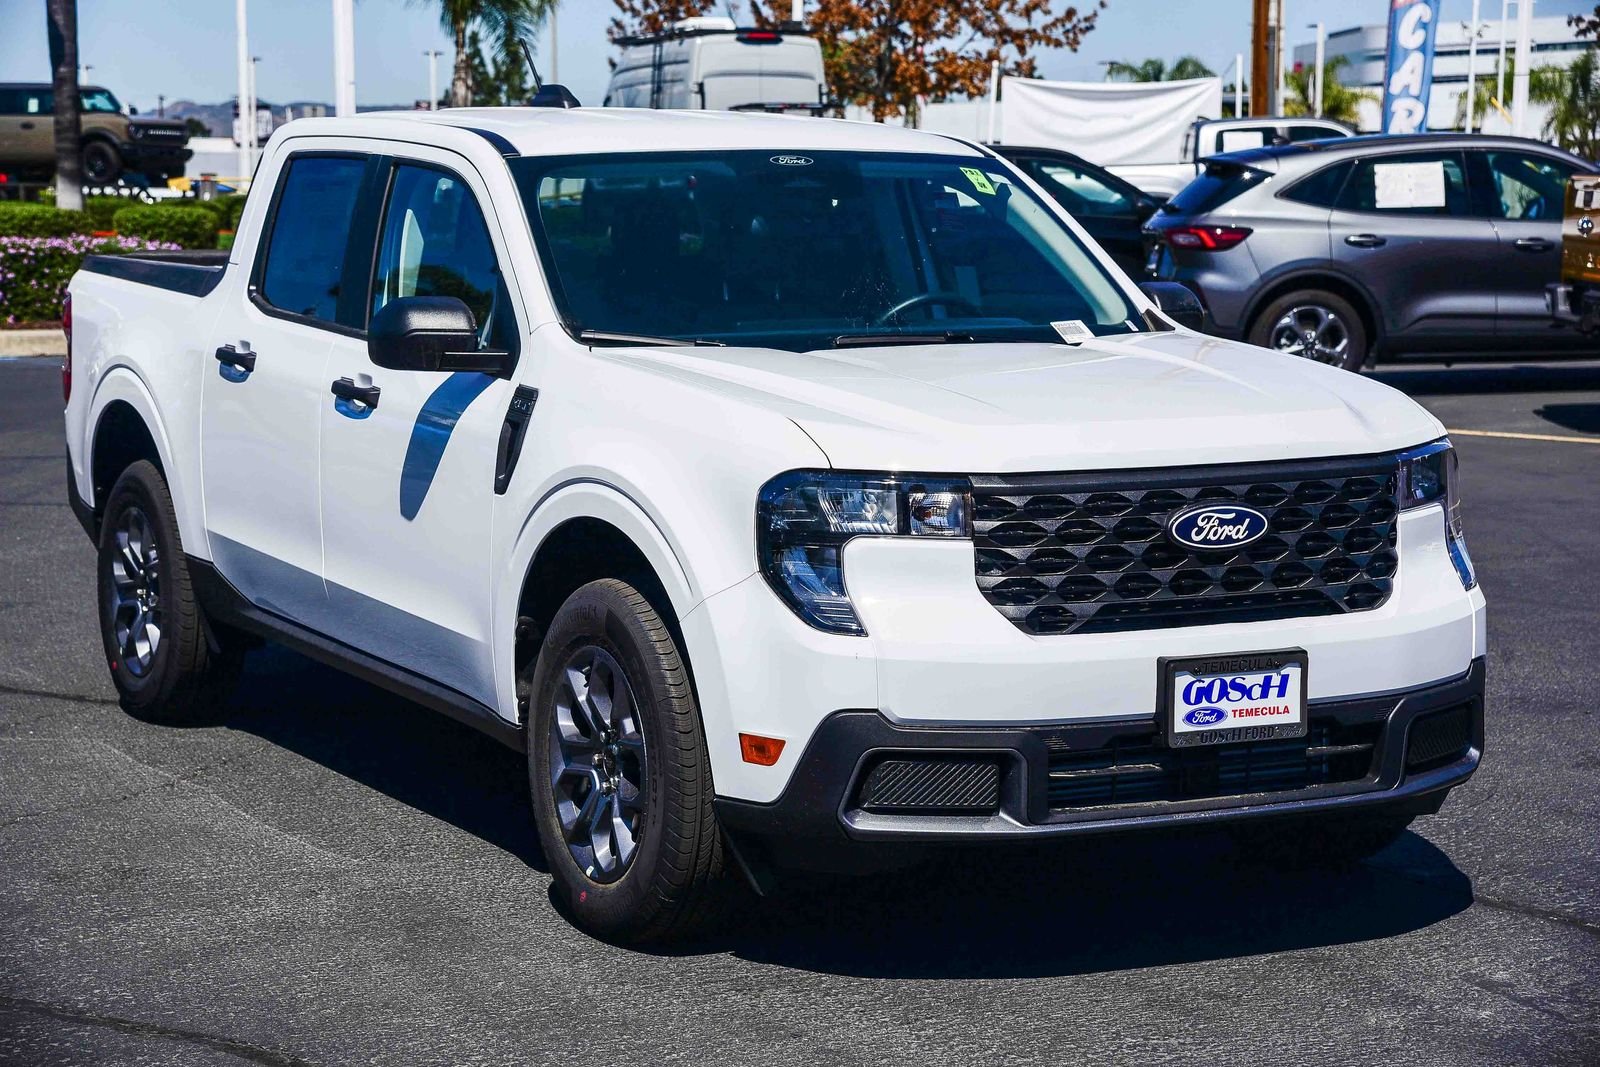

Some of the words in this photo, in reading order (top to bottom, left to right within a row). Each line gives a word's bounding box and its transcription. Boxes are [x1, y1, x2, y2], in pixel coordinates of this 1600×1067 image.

[1389, 2, 1432, 134] CAR
[1191, 512, 1250, 542] Ford
[1203, 658, 1273, 673] TEMECULA
[1192, 710, 1217, 723] Ford
[1231, 705, 1290, 719] TEMECULA
[1244, 726, 1274, 741] FORD
